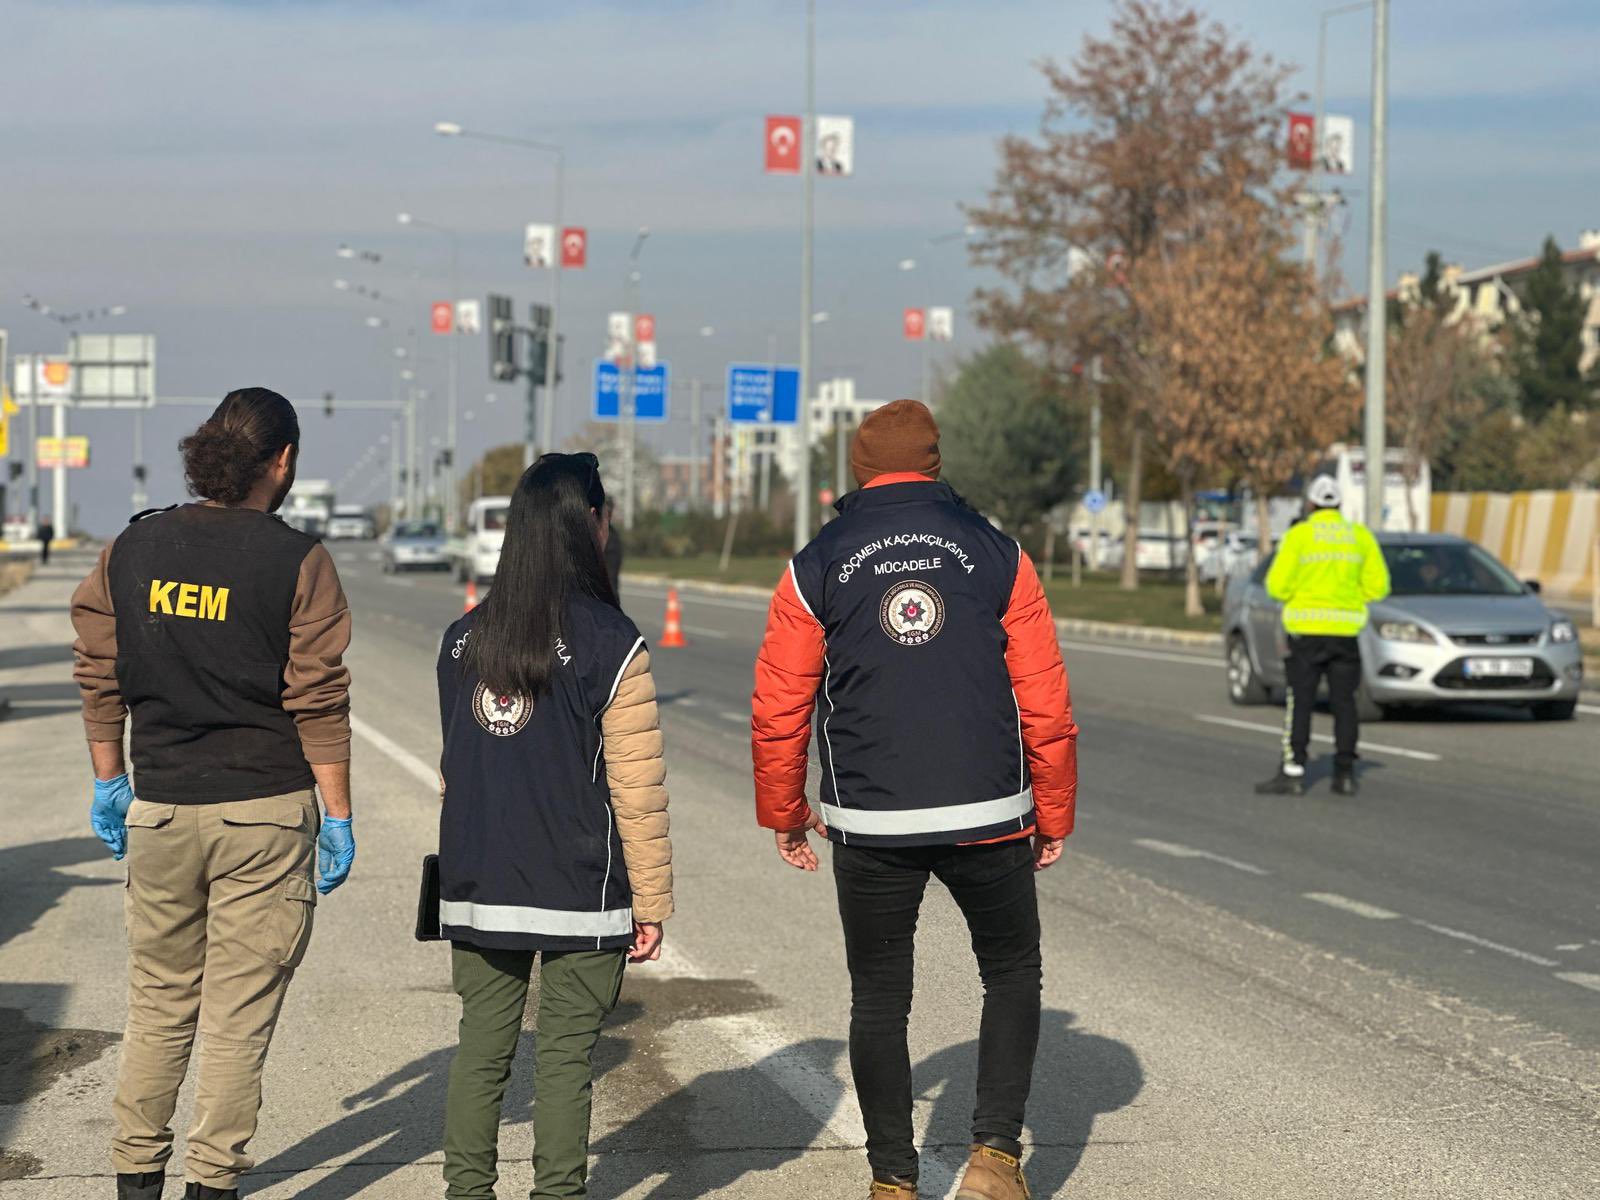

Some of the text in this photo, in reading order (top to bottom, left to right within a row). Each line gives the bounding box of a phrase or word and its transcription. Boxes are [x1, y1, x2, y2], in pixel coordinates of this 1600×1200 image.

[838, 540, 882, 584] GÖÇMEN
[874, 557, 942, 575] MÜCADELE
[149, 579, 230, 621] KEM
